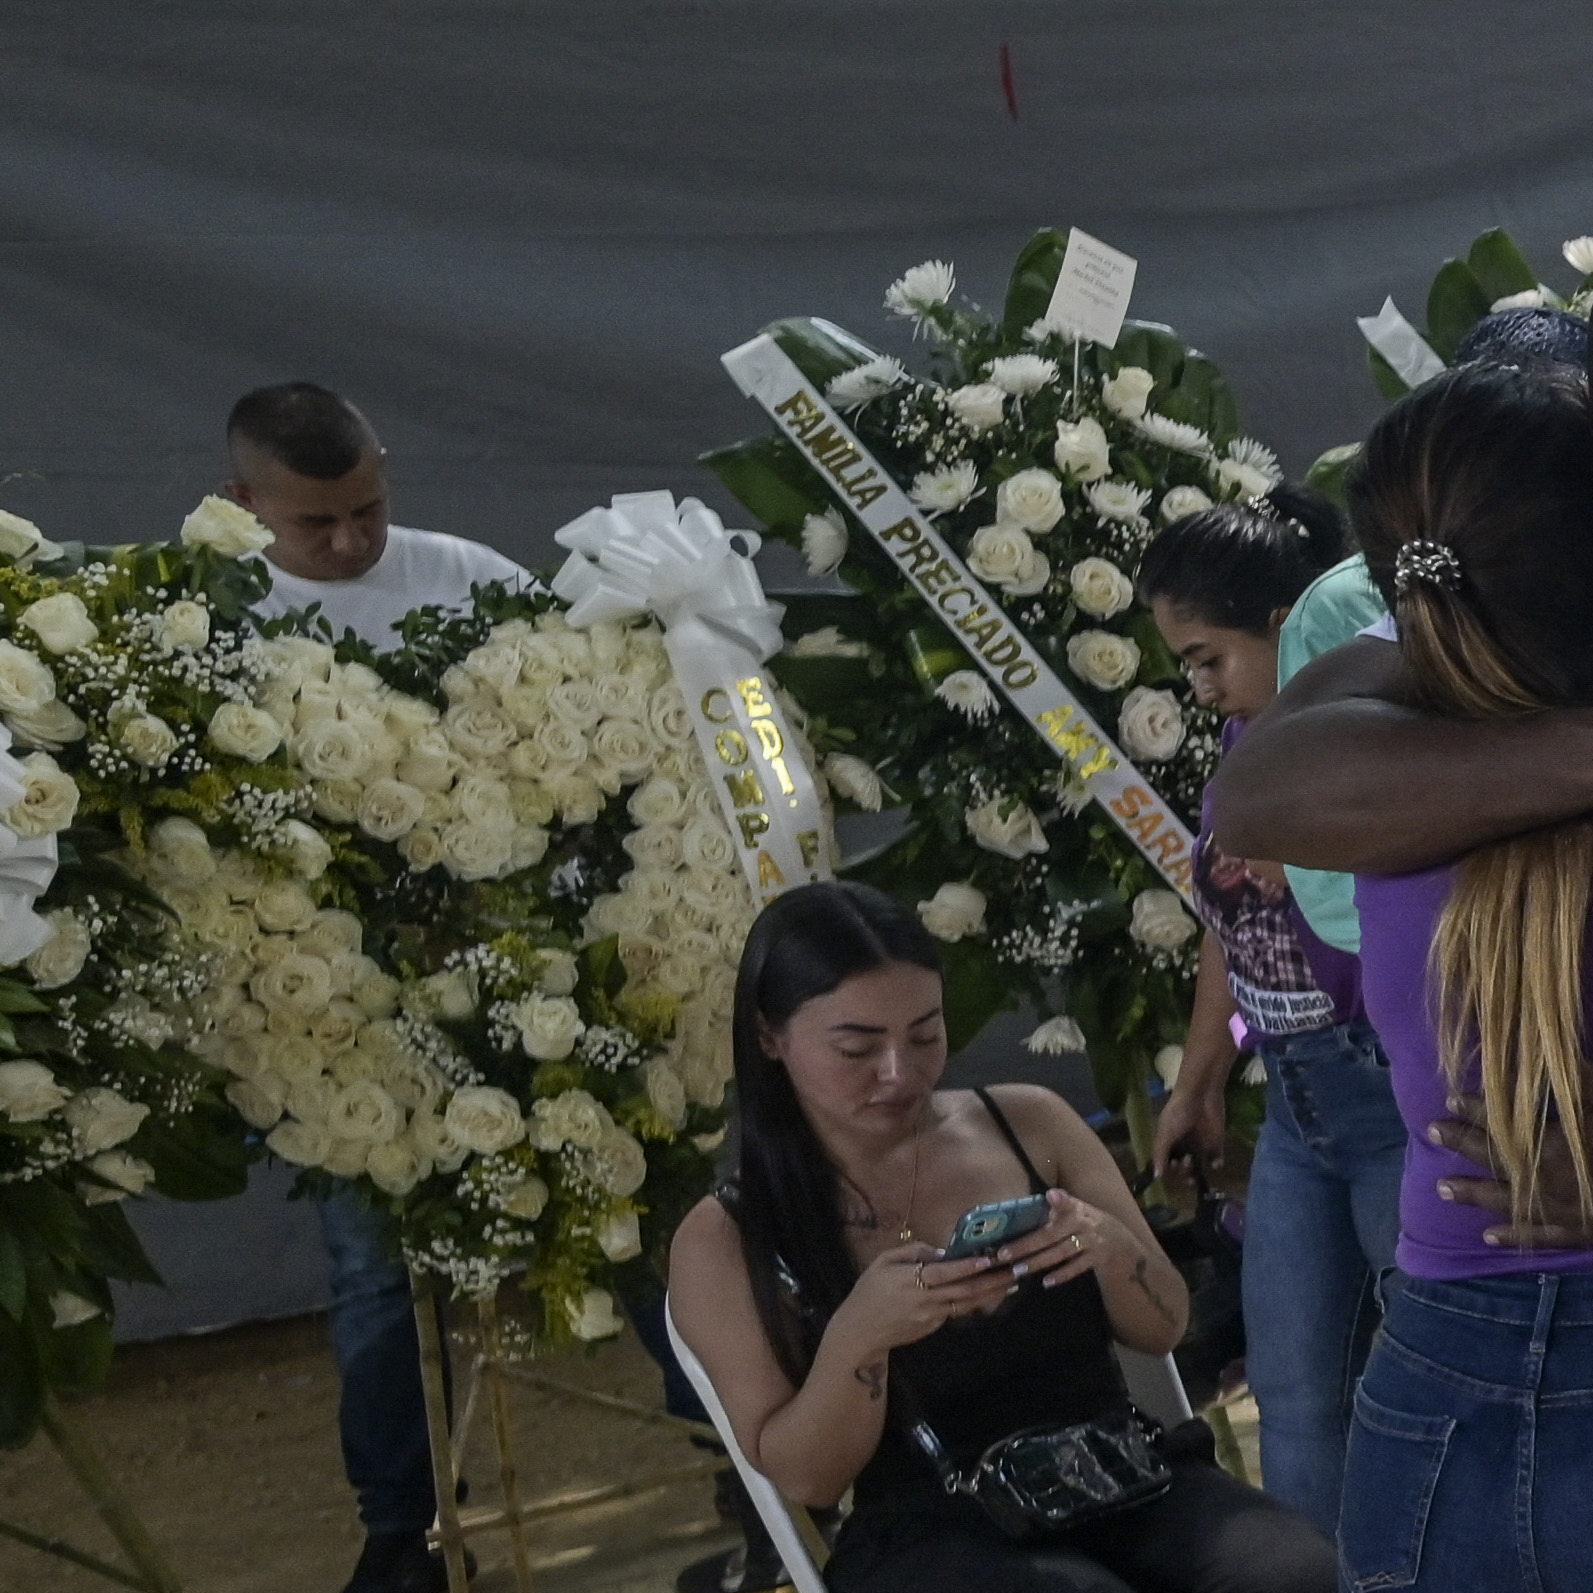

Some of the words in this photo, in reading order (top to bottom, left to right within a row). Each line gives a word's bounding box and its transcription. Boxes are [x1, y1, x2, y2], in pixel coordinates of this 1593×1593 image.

[775, 390, 888, 512] FAMILIA
[880, 516, 1040, 690] PRECIADO
[701, 687, 781, 904] COMPA
